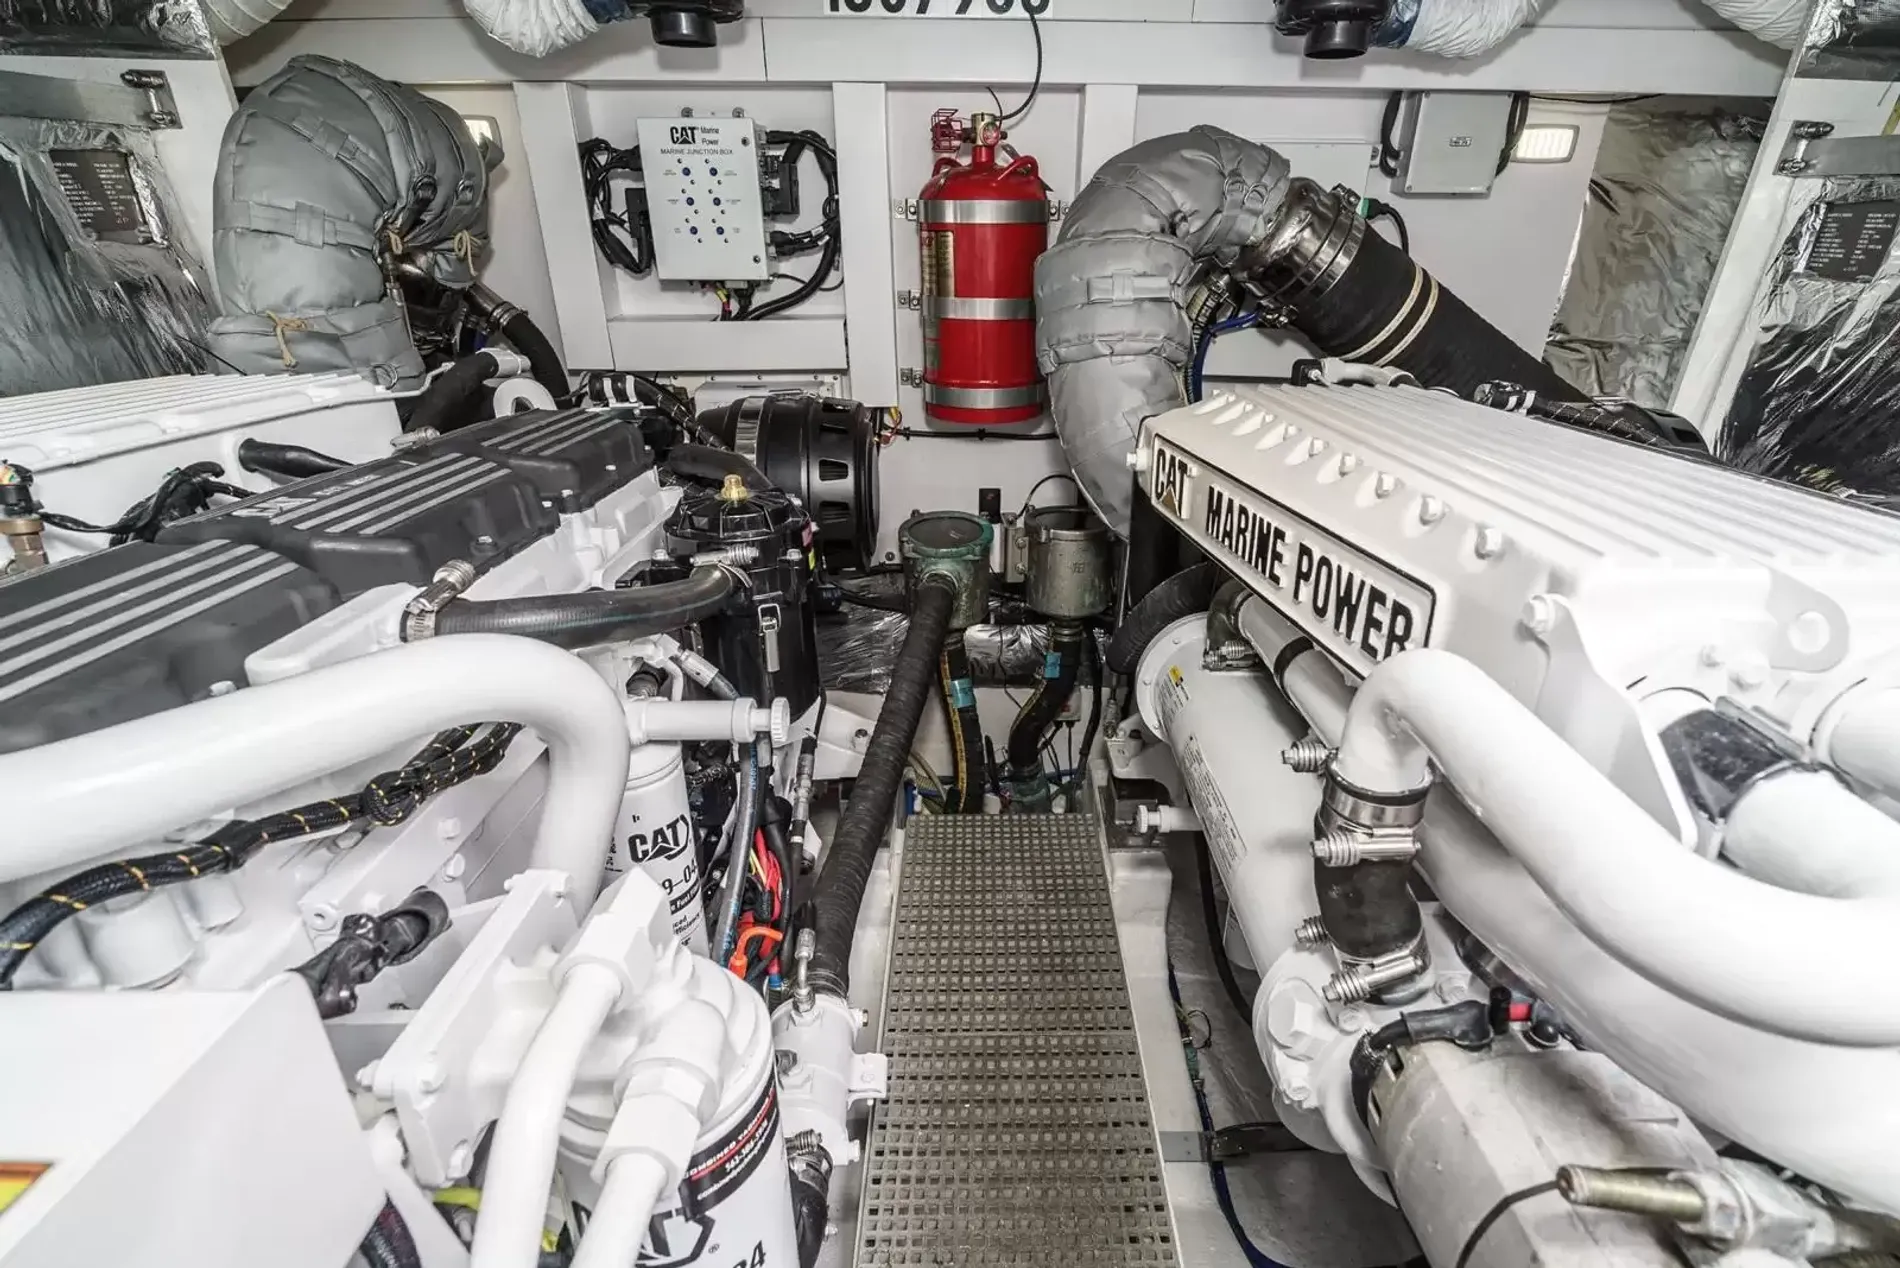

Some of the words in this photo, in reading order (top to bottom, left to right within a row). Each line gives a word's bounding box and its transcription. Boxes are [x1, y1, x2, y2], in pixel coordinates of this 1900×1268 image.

[670, 126, 697, 145] CAT
[1154, 448, 1189, 519] CAT
[1205, 485, 1287, 588] MARINE
[1293, 541, 1414, 662] POWER
[628, 816, 682, 863] CAT
